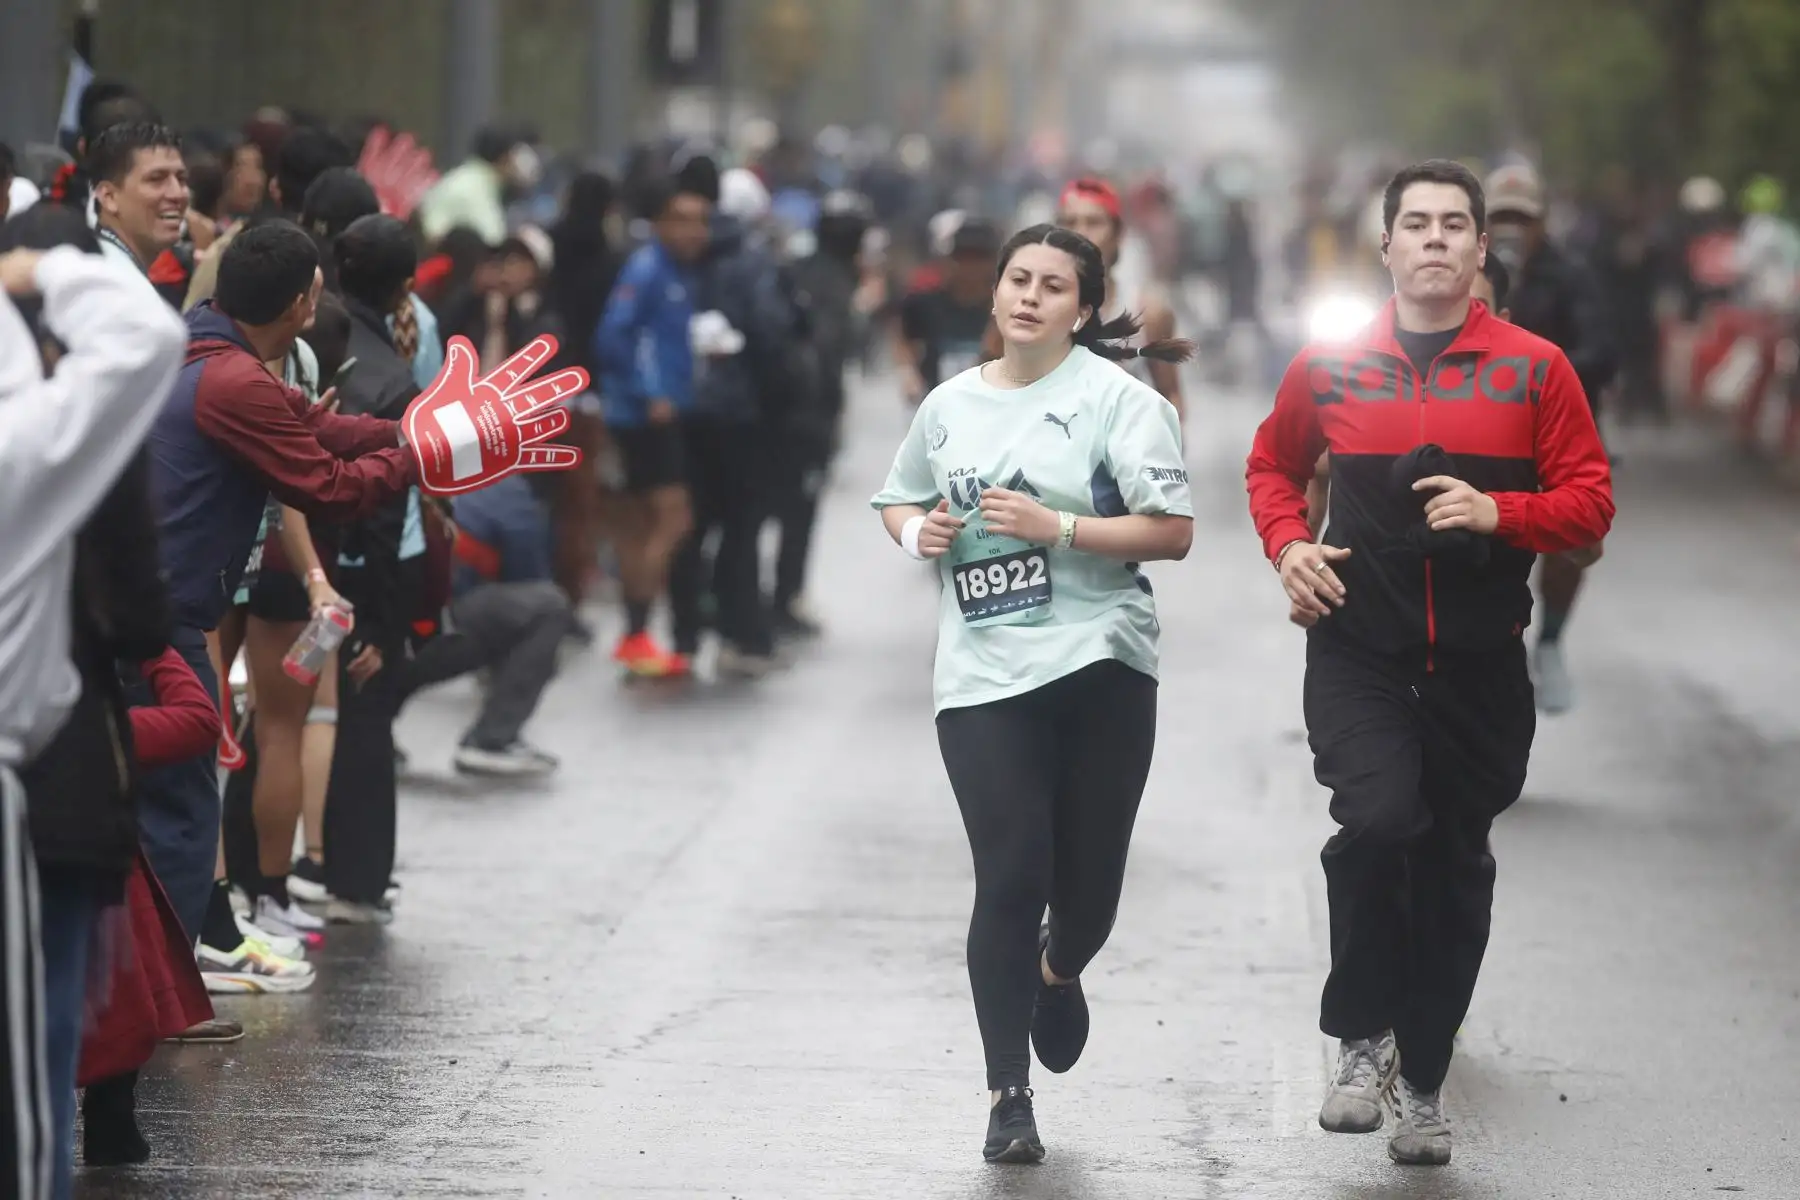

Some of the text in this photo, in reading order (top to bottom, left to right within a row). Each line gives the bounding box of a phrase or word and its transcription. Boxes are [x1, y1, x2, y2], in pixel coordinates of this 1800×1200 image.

[1147, 466, 1188, 484] NITRO
[988, 547, 1001, 556] 10K
[956, 555, 1047, 601] 18922
